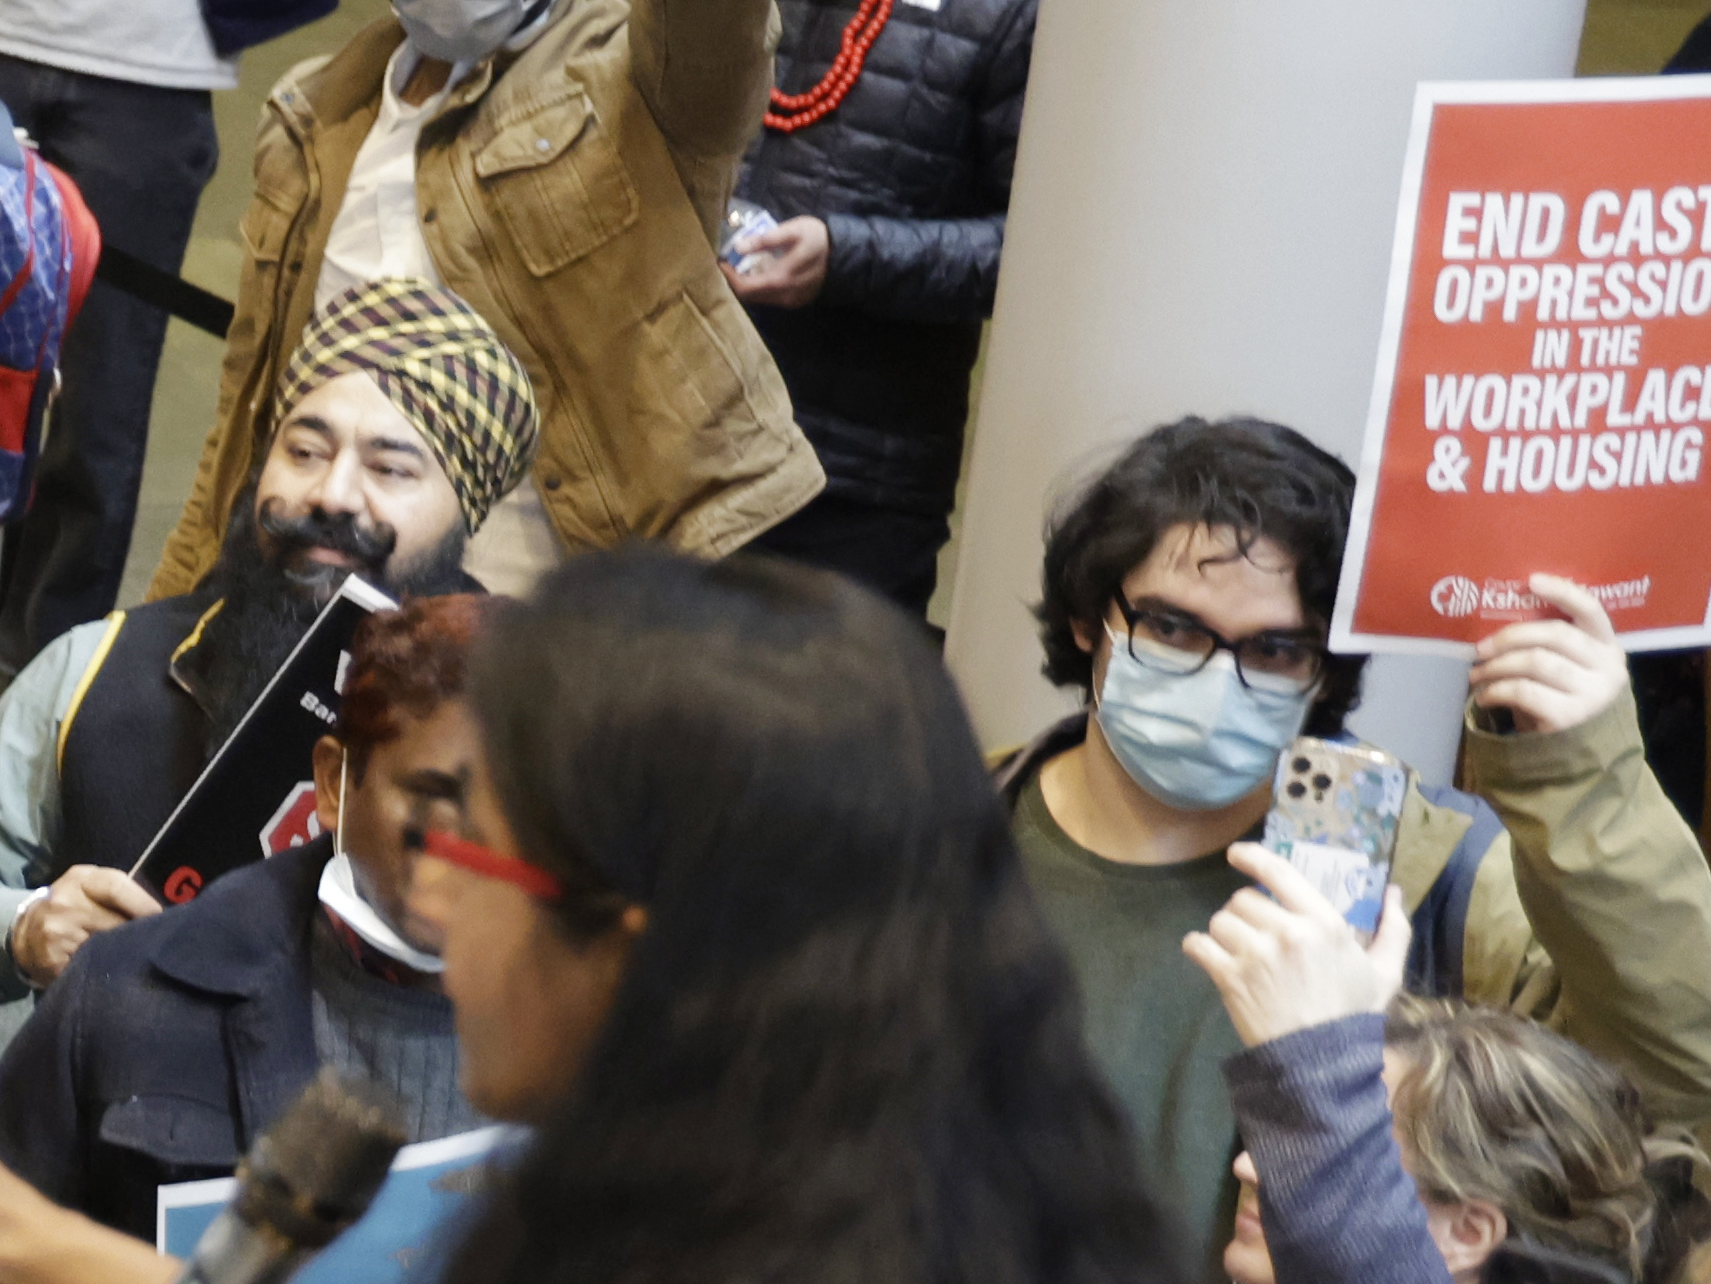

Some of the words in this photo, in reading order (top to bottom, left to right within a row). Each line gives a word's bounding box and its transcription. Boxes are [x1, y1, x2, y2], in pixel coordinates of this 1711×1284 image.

[1442, 191, 1565, 260] END
[1433, 257, 1711, 323] OPPRESSIO
[1531, 327, 1571, 370] IN
[1578, 324, 1642, 367] THE
[1426, 437, 1470, 493] &
[1483, 427, 1704, 493] HOUSING
